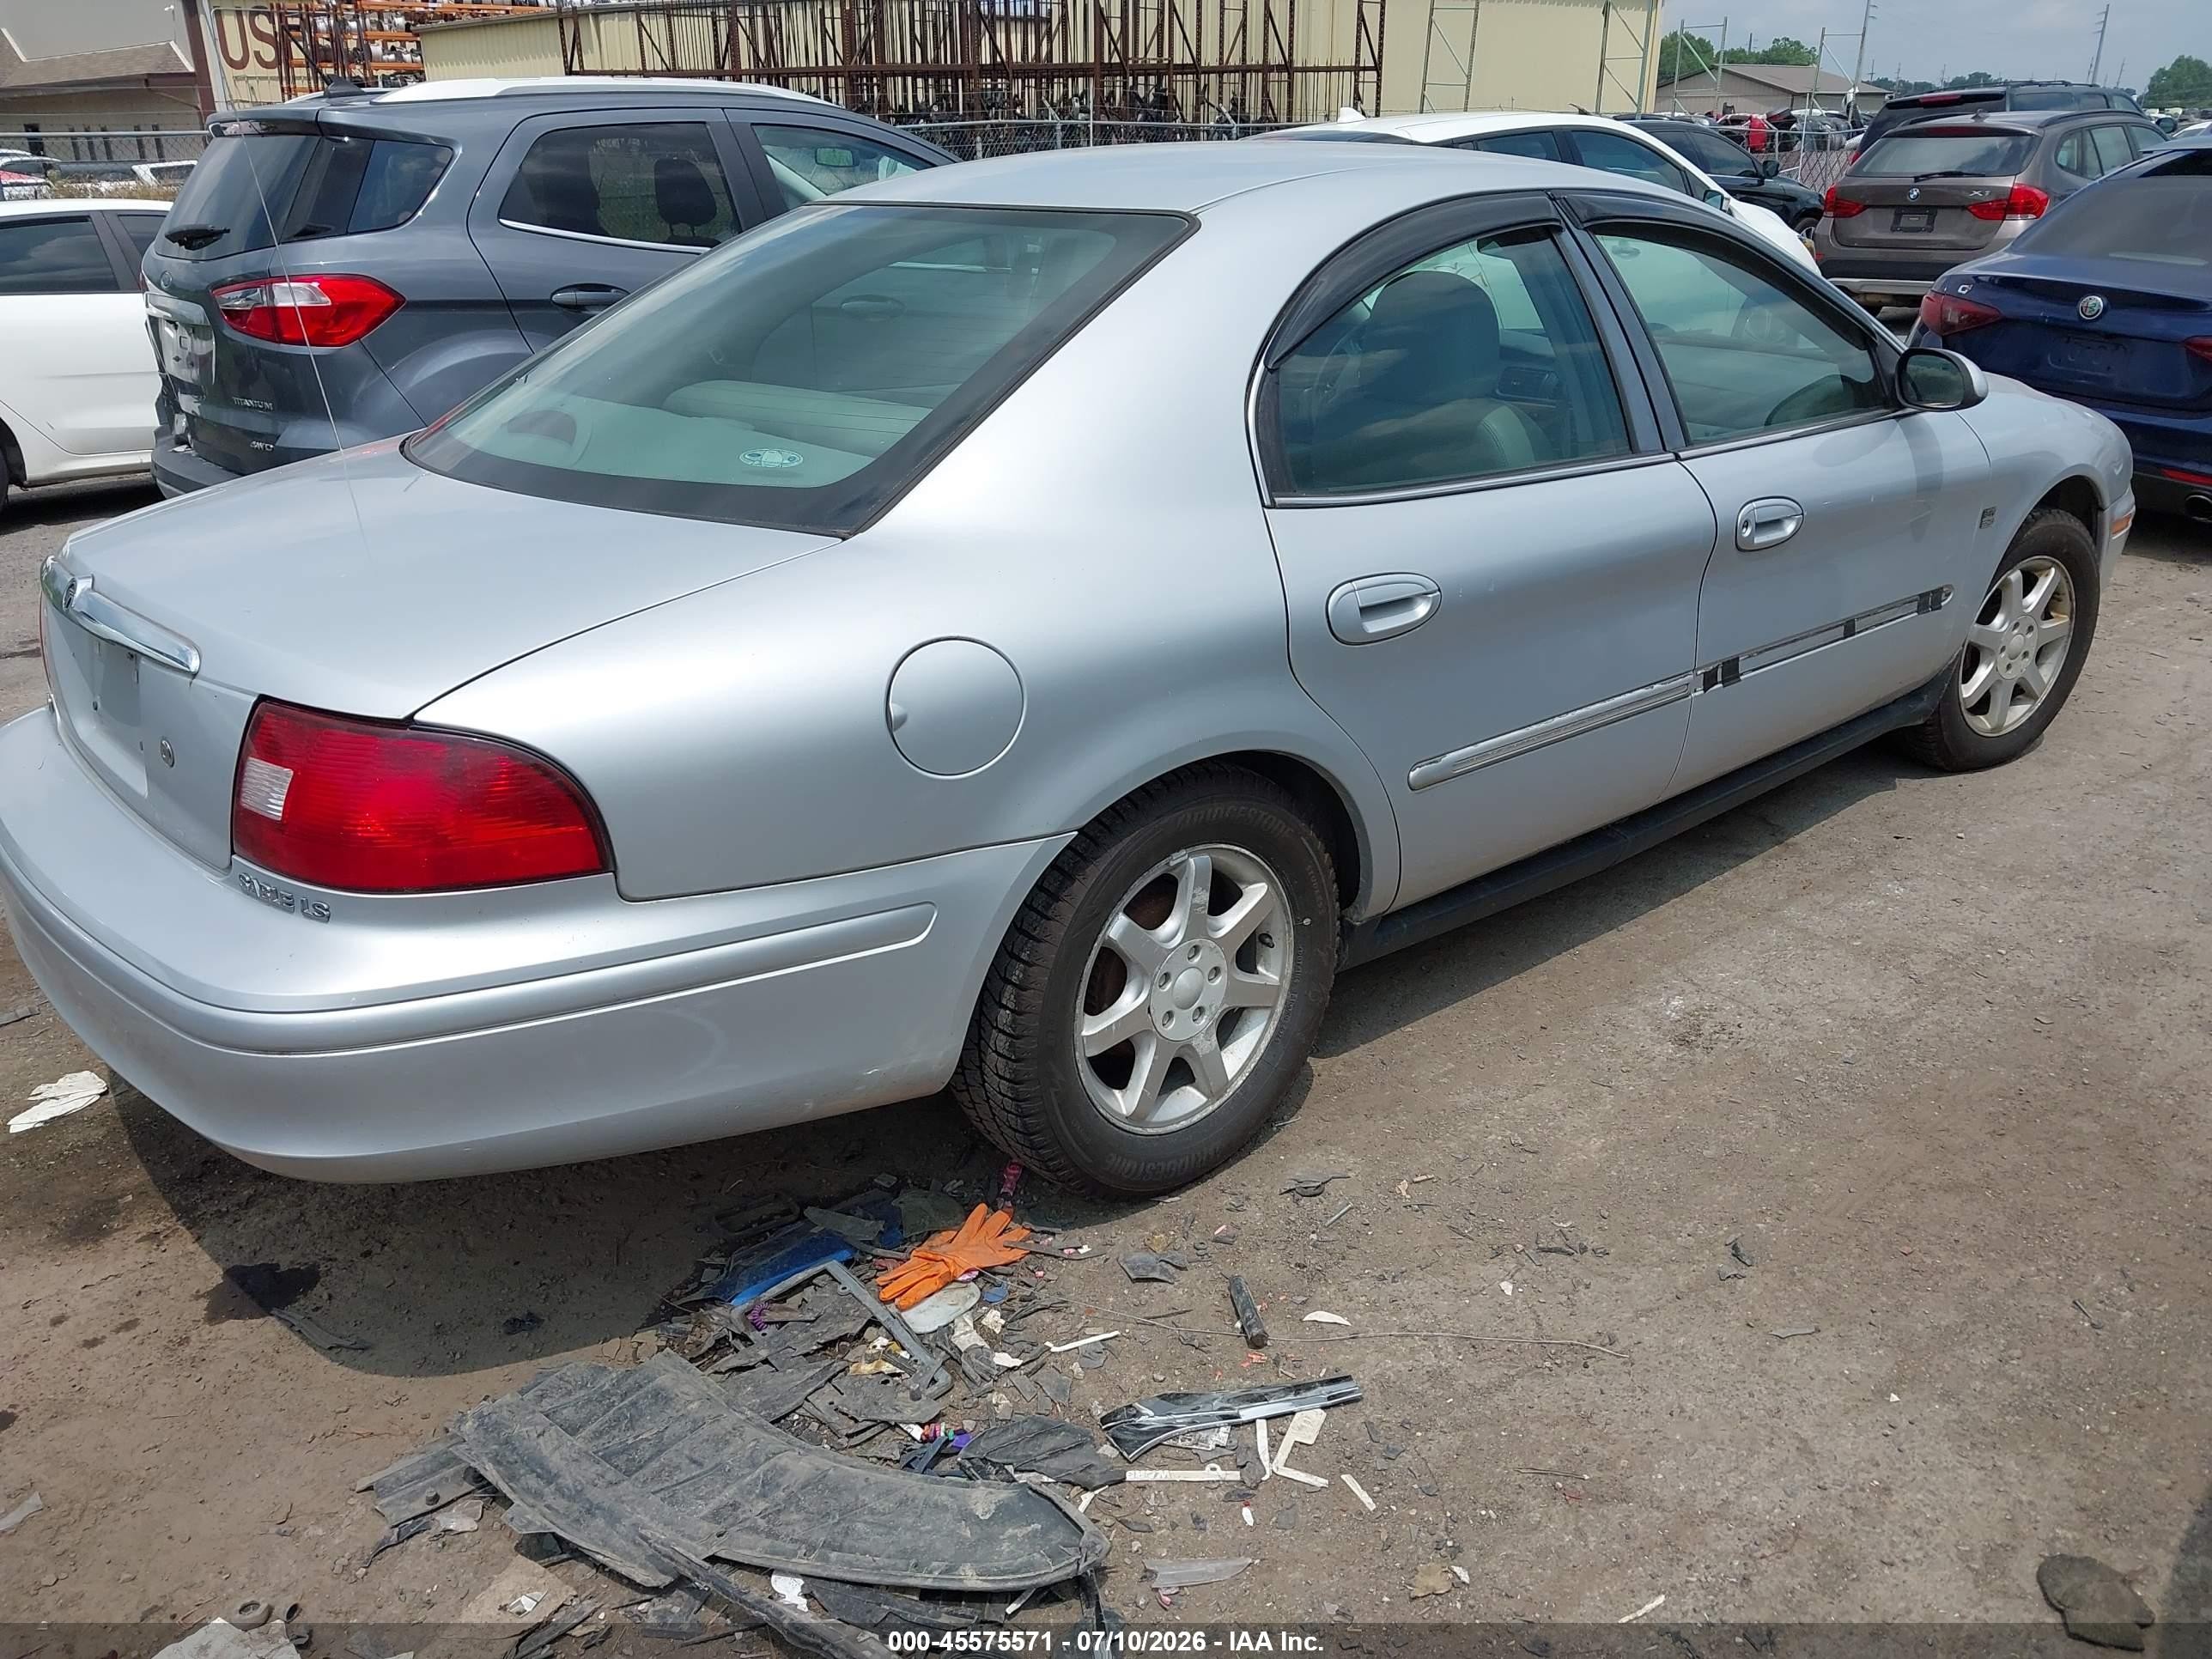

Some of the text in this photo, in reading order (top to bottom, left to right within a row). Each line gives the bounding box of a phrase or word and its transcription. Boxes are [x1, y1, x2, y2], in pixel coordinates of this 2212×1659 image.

[231, 396, 274, 411] TITANIUM
[239, 872, 331, 924] SABLE LS
